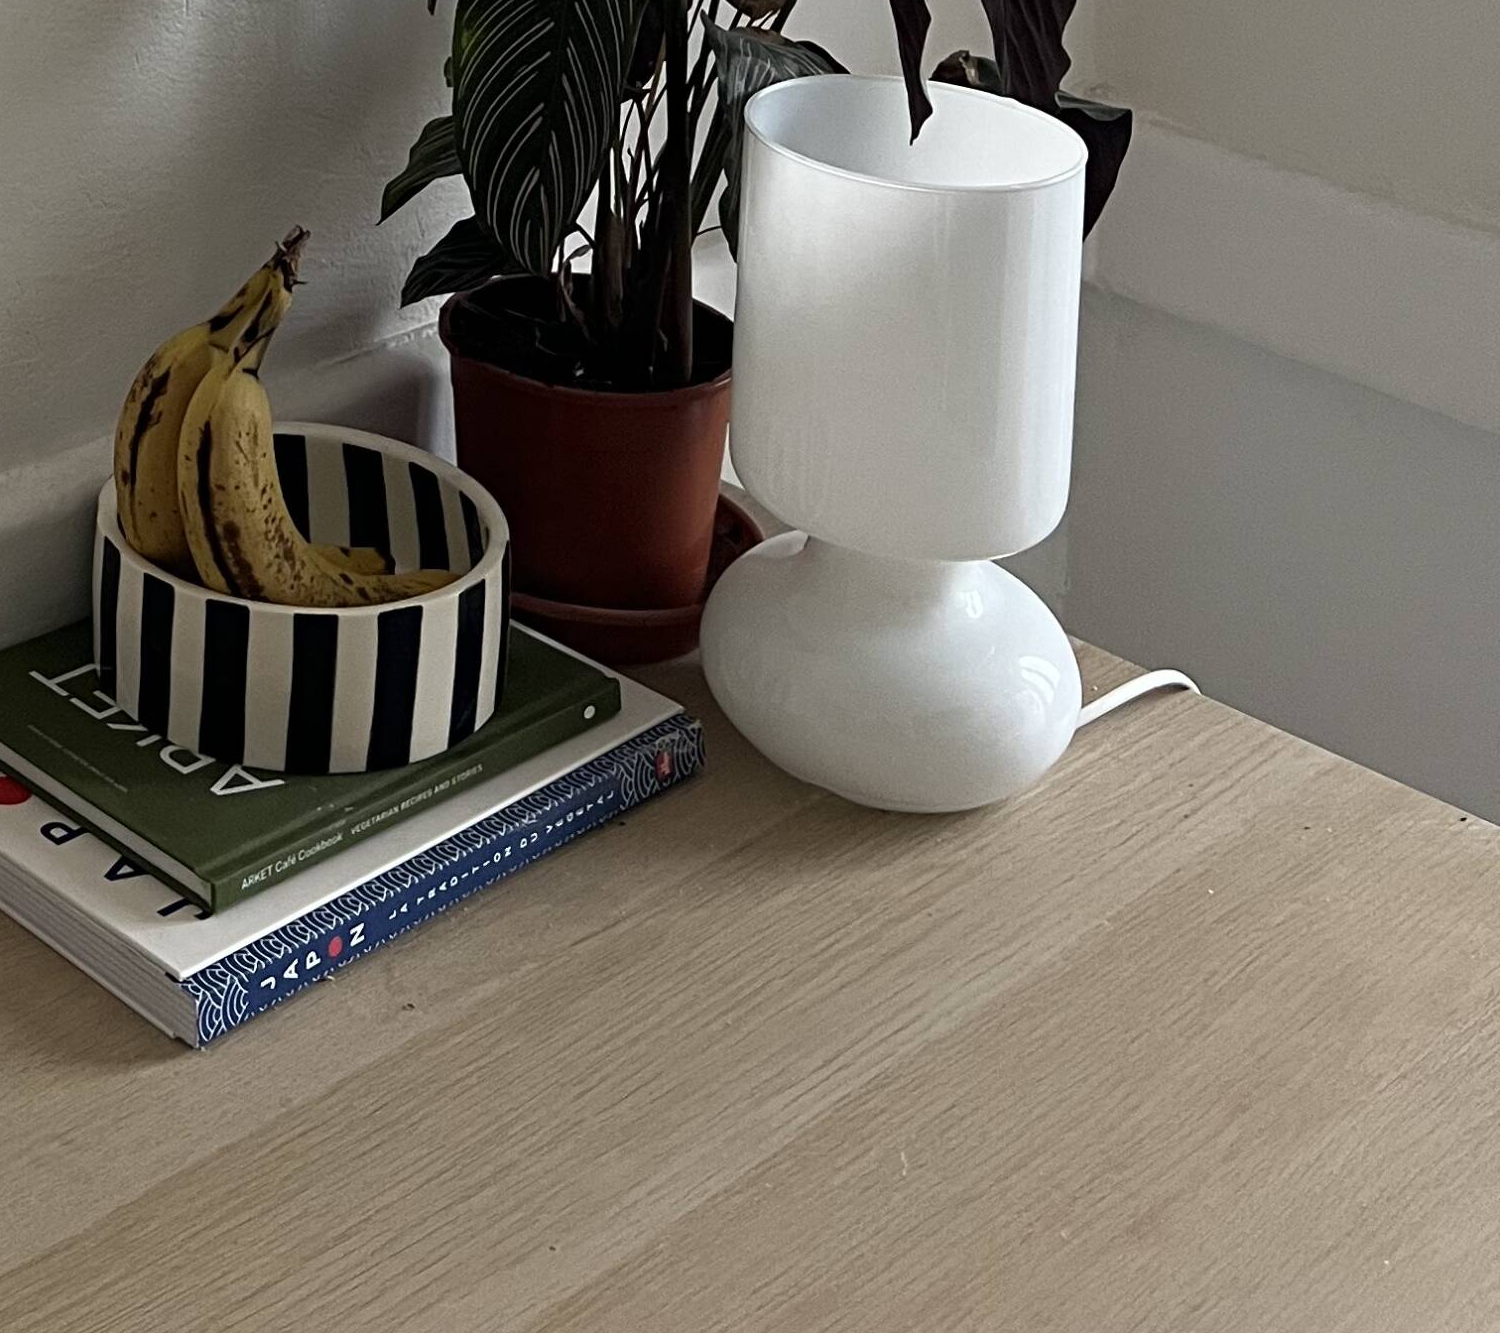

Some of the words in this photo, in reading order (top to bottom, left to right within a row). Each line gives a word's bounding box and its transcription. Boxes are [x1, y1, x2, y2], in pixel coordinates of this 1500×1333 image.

[241, 865, 273, 890] ARKET
[275, 855, 297, 872] Café
[298, 833, 343, 860] Cookbook
[350, 806, 399, 835] VEGETARIAN
[400, 792, 432, 811] RECIPES
[434, 782, 450, 794] AND
[451, 764, 483, 785] STORIES
[388, 903, 408, 920] LA
[416, 847, 512, 906] TRADITION
[520, 832, 538, 849] DU
